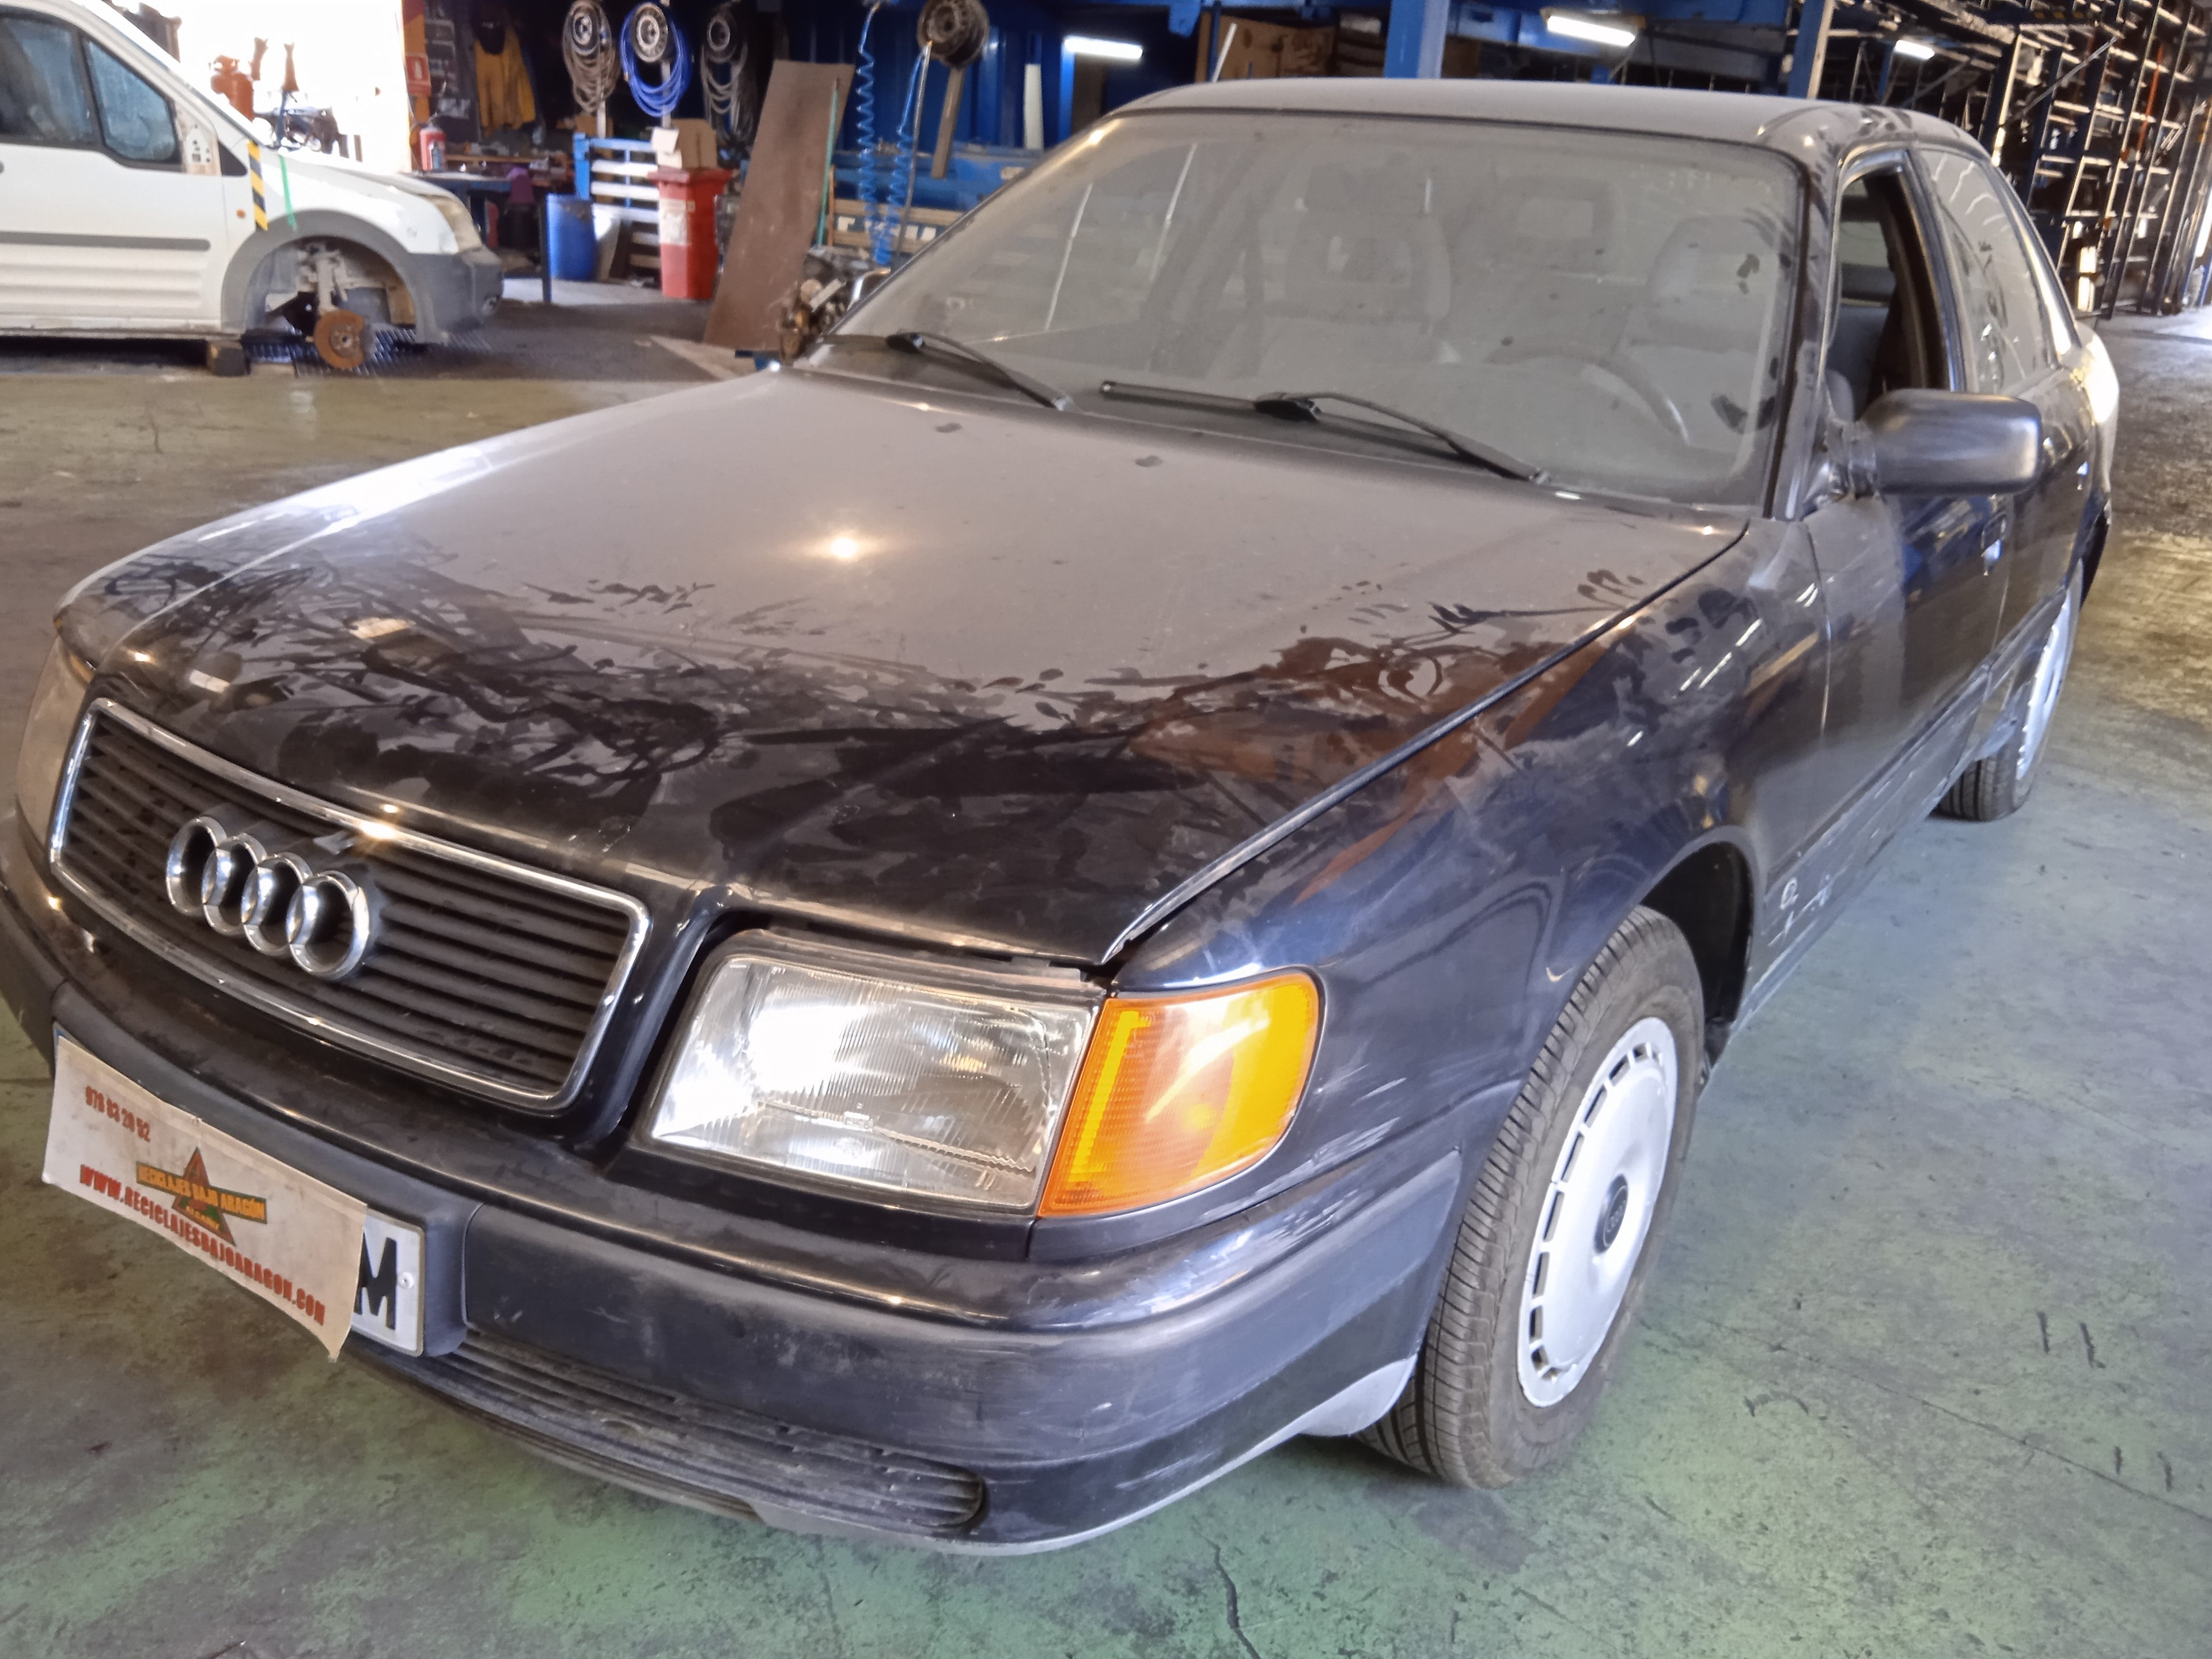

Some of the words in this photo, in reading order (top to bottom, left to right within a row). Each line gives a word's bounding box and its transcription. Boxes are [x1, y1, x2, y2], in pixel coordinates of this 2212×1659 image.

[138, 1165, 191, 1198] RECICLAJES
[192, 1183, 219, 1207] BAJO
[353, 1230, 396, 1331] M
